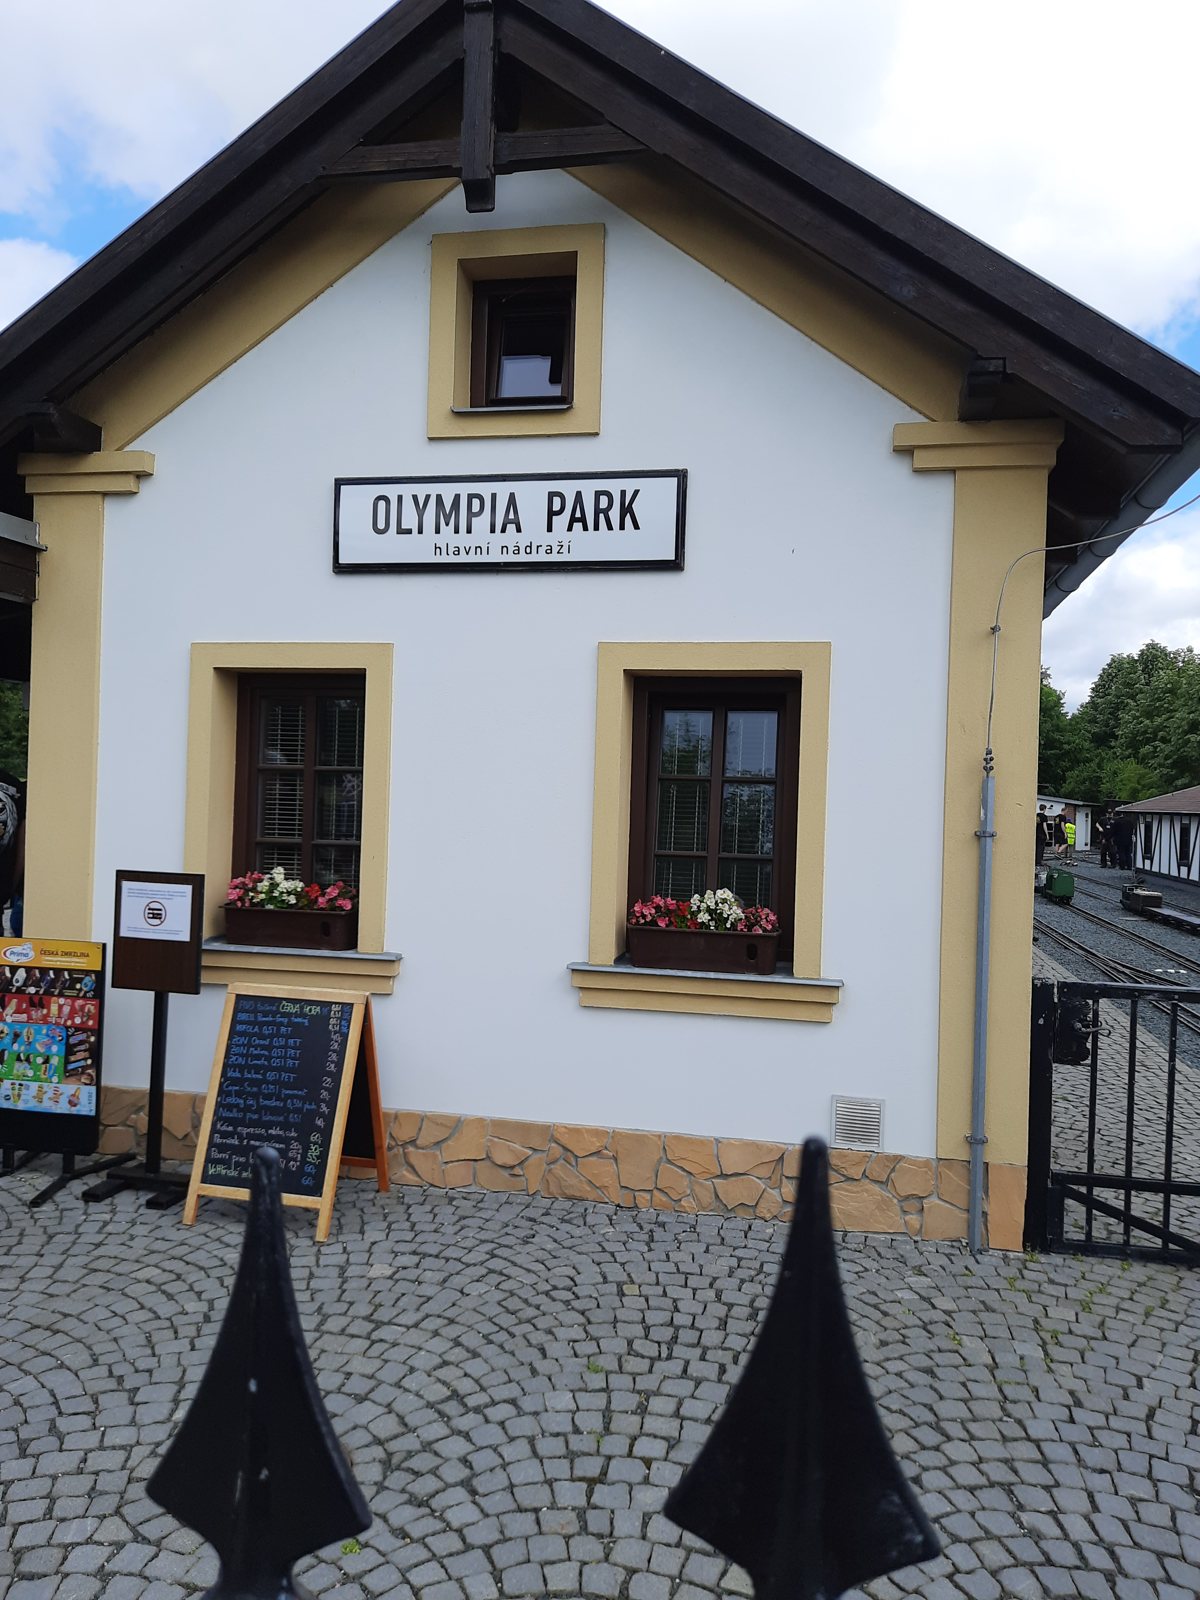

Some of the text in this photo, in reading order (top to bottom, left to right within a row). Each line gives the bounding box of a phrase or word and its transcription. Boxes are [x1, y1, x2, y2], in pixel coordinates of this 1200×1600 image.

[371, 488, 642, 535] OLYMPIA PARK
[434, 539, 573, 556] hlavní nádraží
